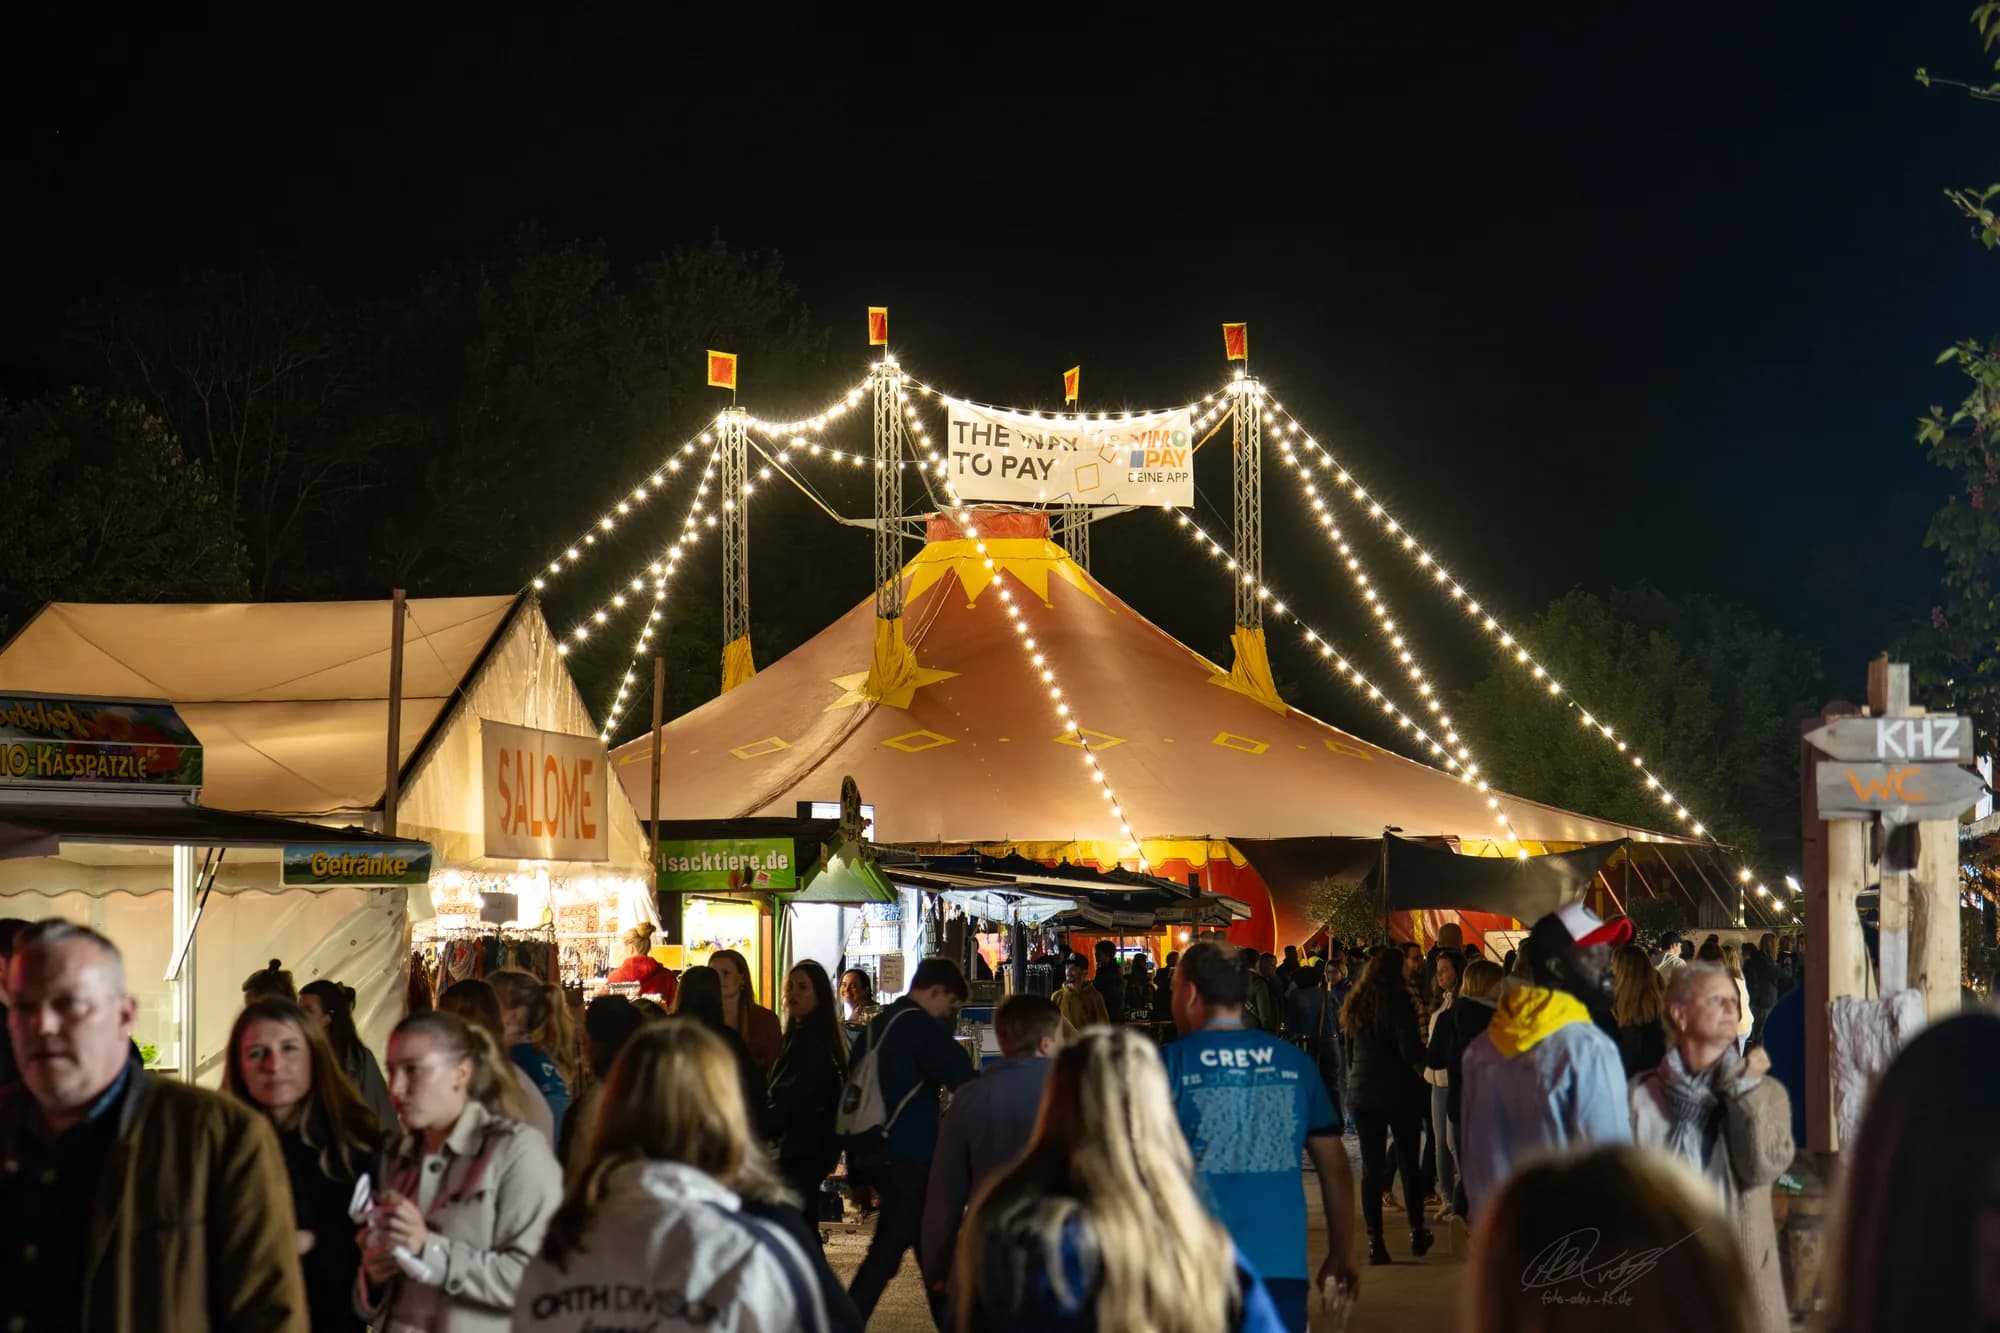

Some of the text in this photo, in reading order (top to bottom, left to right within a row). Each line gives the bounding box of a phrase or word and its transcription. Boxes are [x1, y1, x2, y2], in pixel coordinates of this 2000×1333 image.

[952, 420, 1010, 448] THE
[952, 451, 1057, 481] TO PAY
[1145, 449, 1187, 468] PAY
[1127, 472, 1189, 483] DEINE APP
[1876, 718, 1961, 759] KHZ
[498, 747, 596, 840] SALOME
[1846, 767, 1927, 805] WC
[311, 851, 408, 878] Getränke
[658, 850, 789, 872] lsacktiere.de
[1199, 1047, 1274, 1068] CREW
